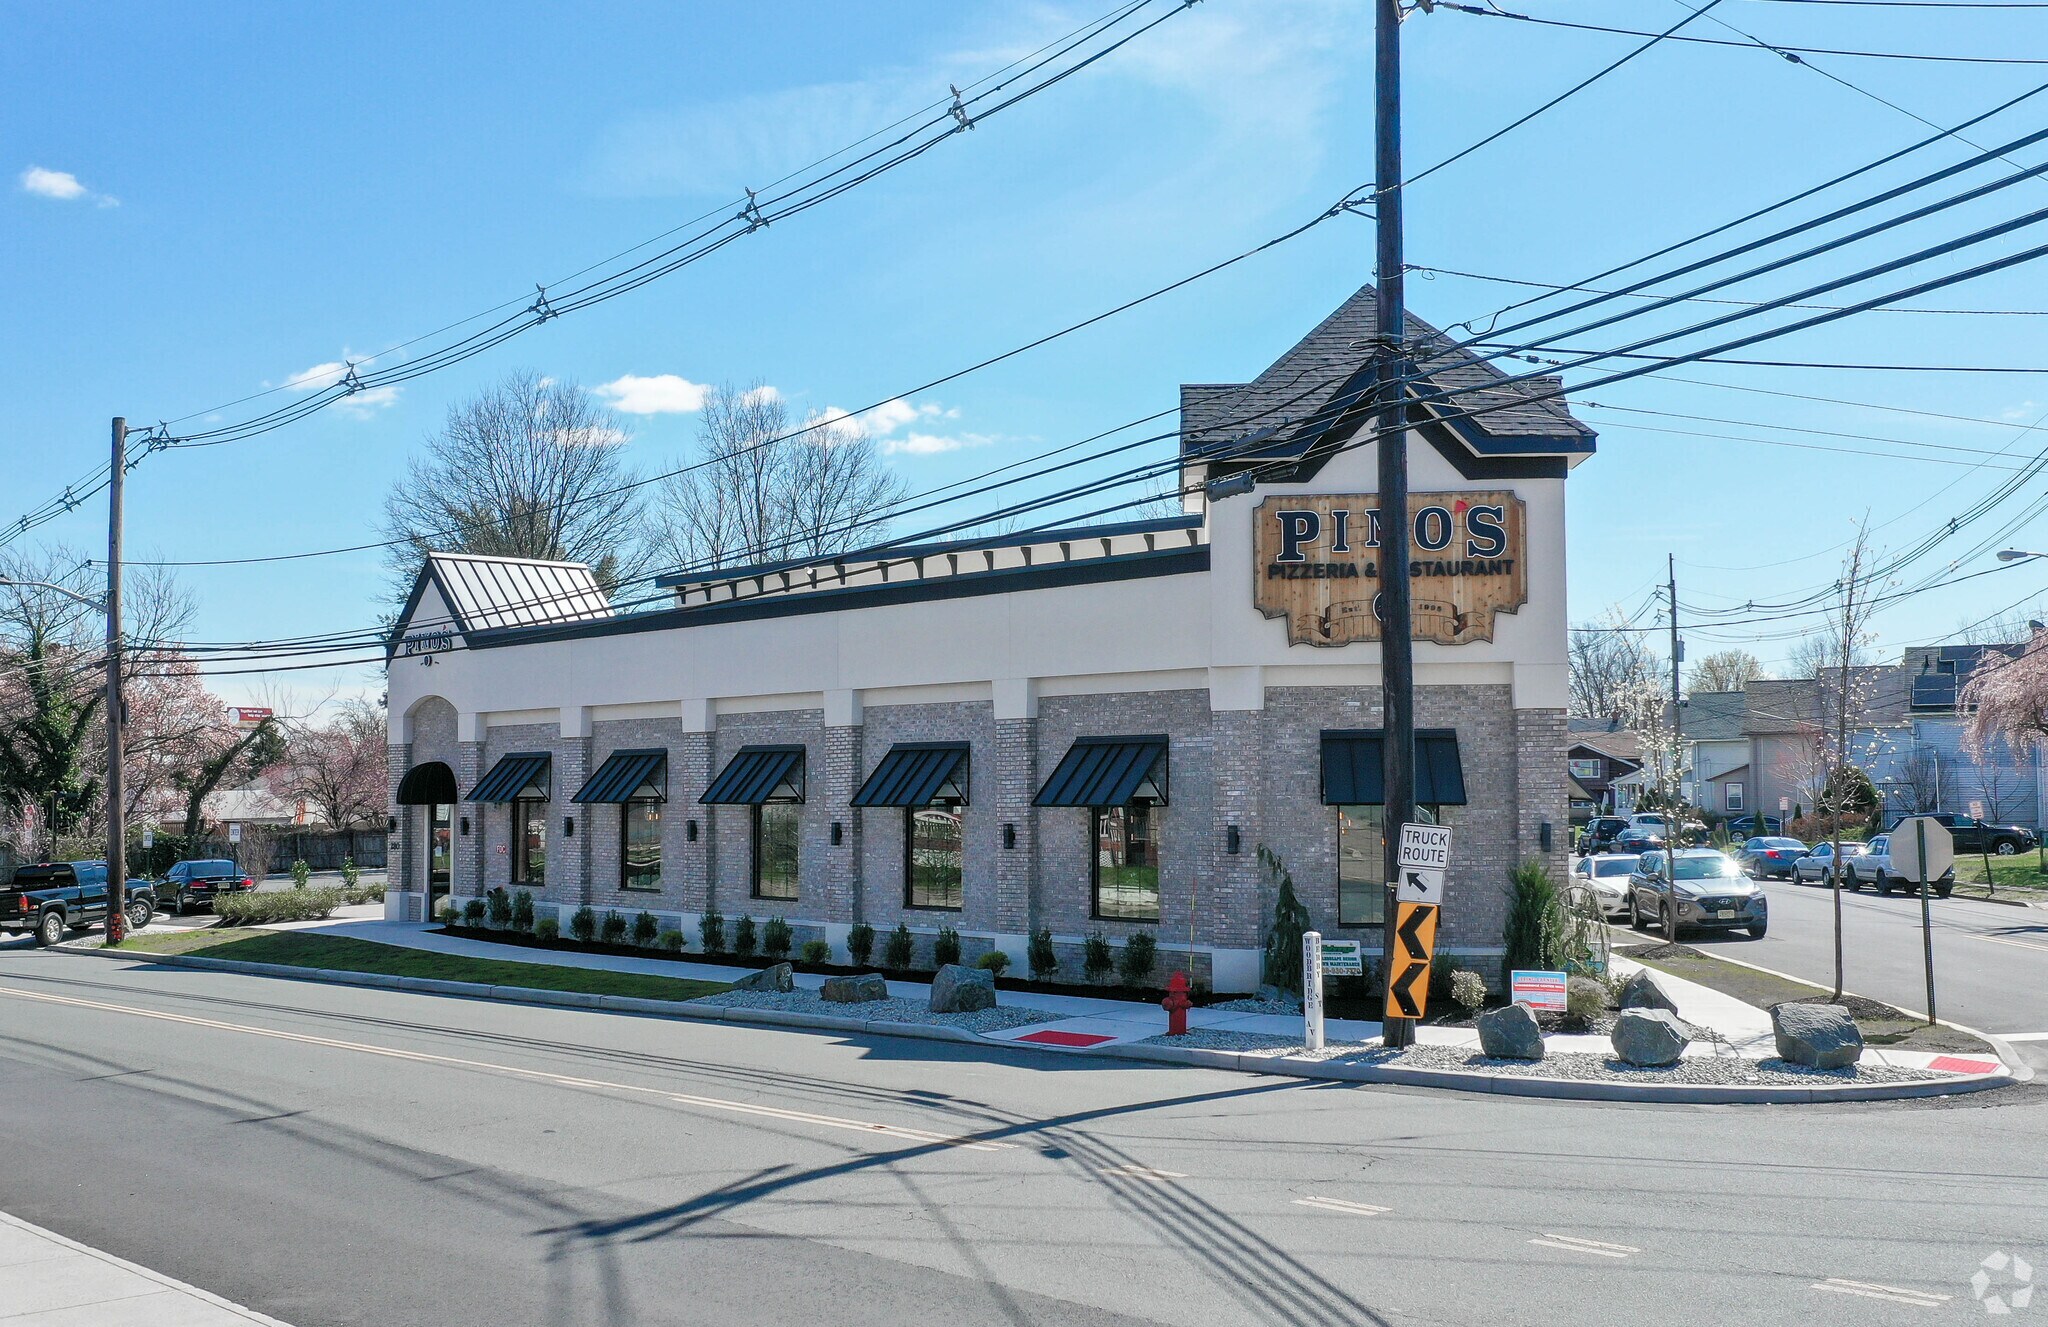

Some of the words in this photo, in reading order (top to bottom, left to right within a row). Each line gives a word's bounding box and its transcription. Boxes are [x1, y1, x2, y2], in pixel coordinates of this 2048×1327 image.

[1268, 561, 1359, 580] PIZZERIA
[1365, 562, 1378, 578] &
[1410, 559, 1515, 577] STAURANT
[1405, 829, 1448, 846] TRUCK
[1403, 846, 1445, 862] ROUTE
[1304, 937, 1314, 1009] WOODBRIDGE
